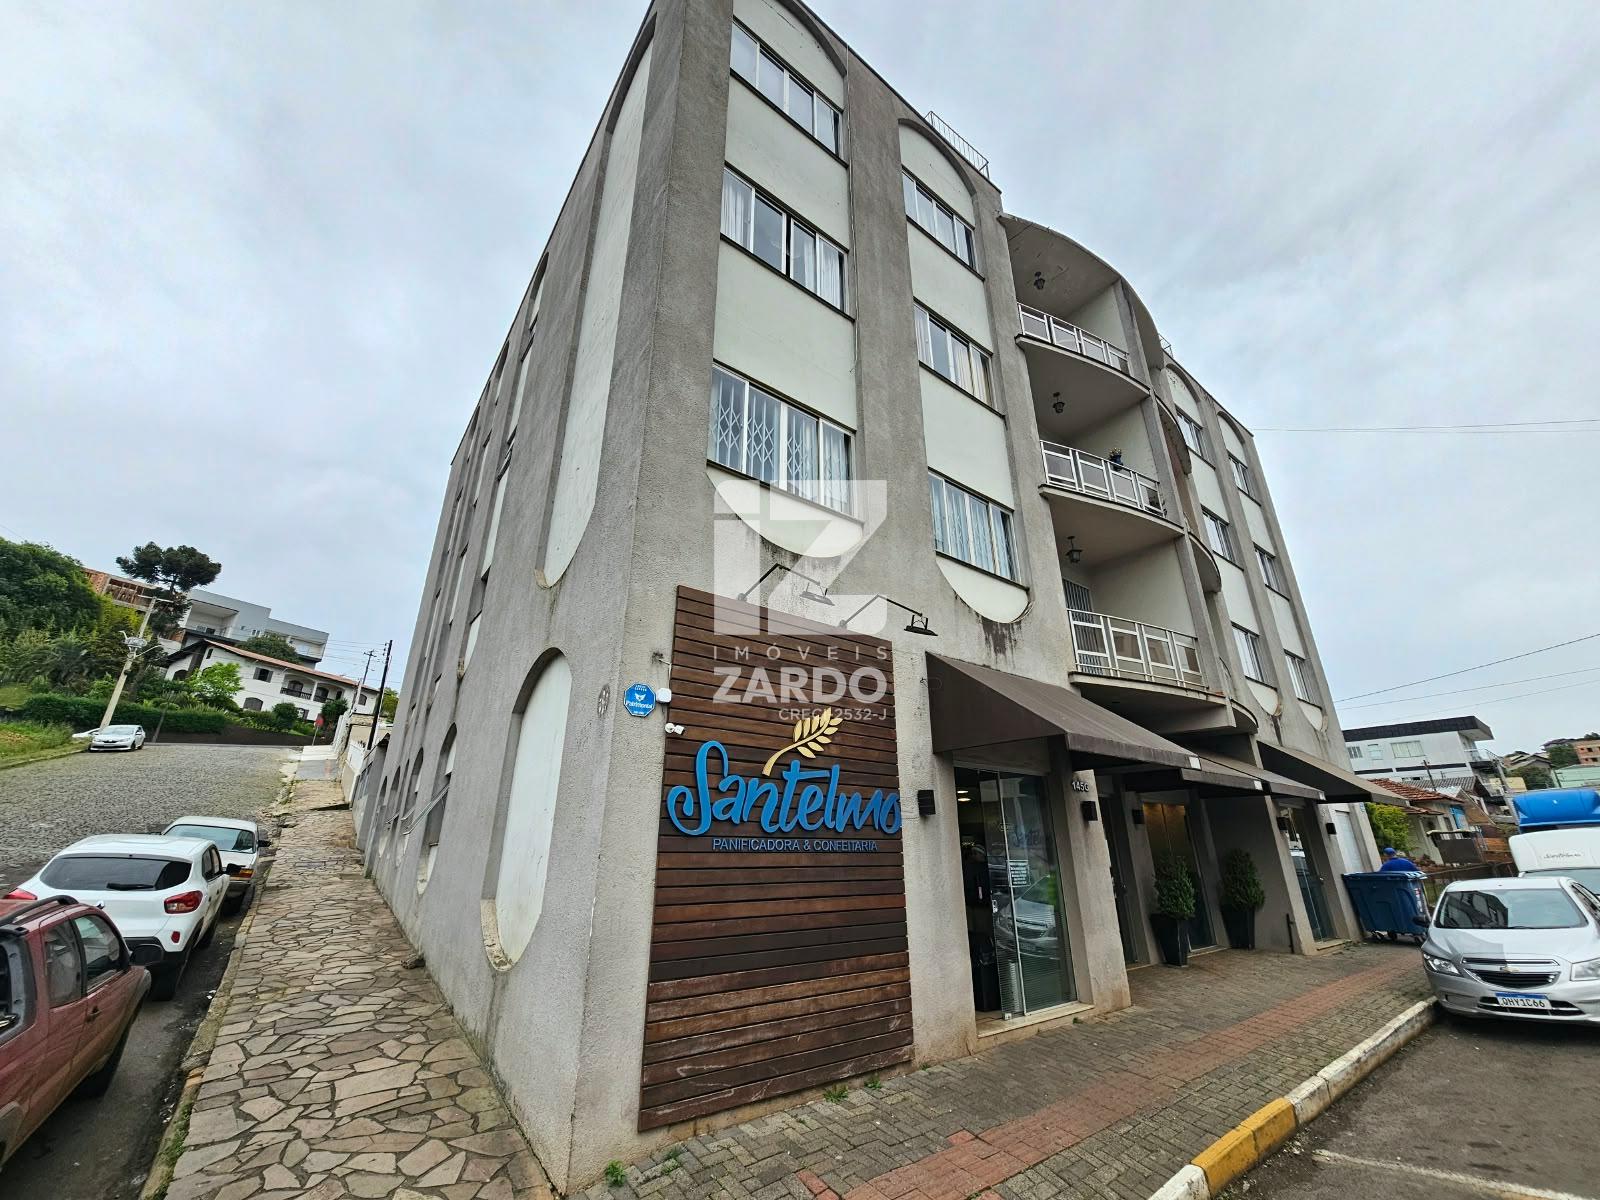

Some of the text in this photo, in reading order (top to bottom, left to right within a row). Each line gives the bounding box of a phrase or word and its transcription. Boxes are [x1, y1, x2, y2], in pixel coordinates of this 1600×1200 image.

[666, 740, 902, 836] Santelmo
[712, 838, 878, 852] PANIFICADORA & CONFEITARIA
